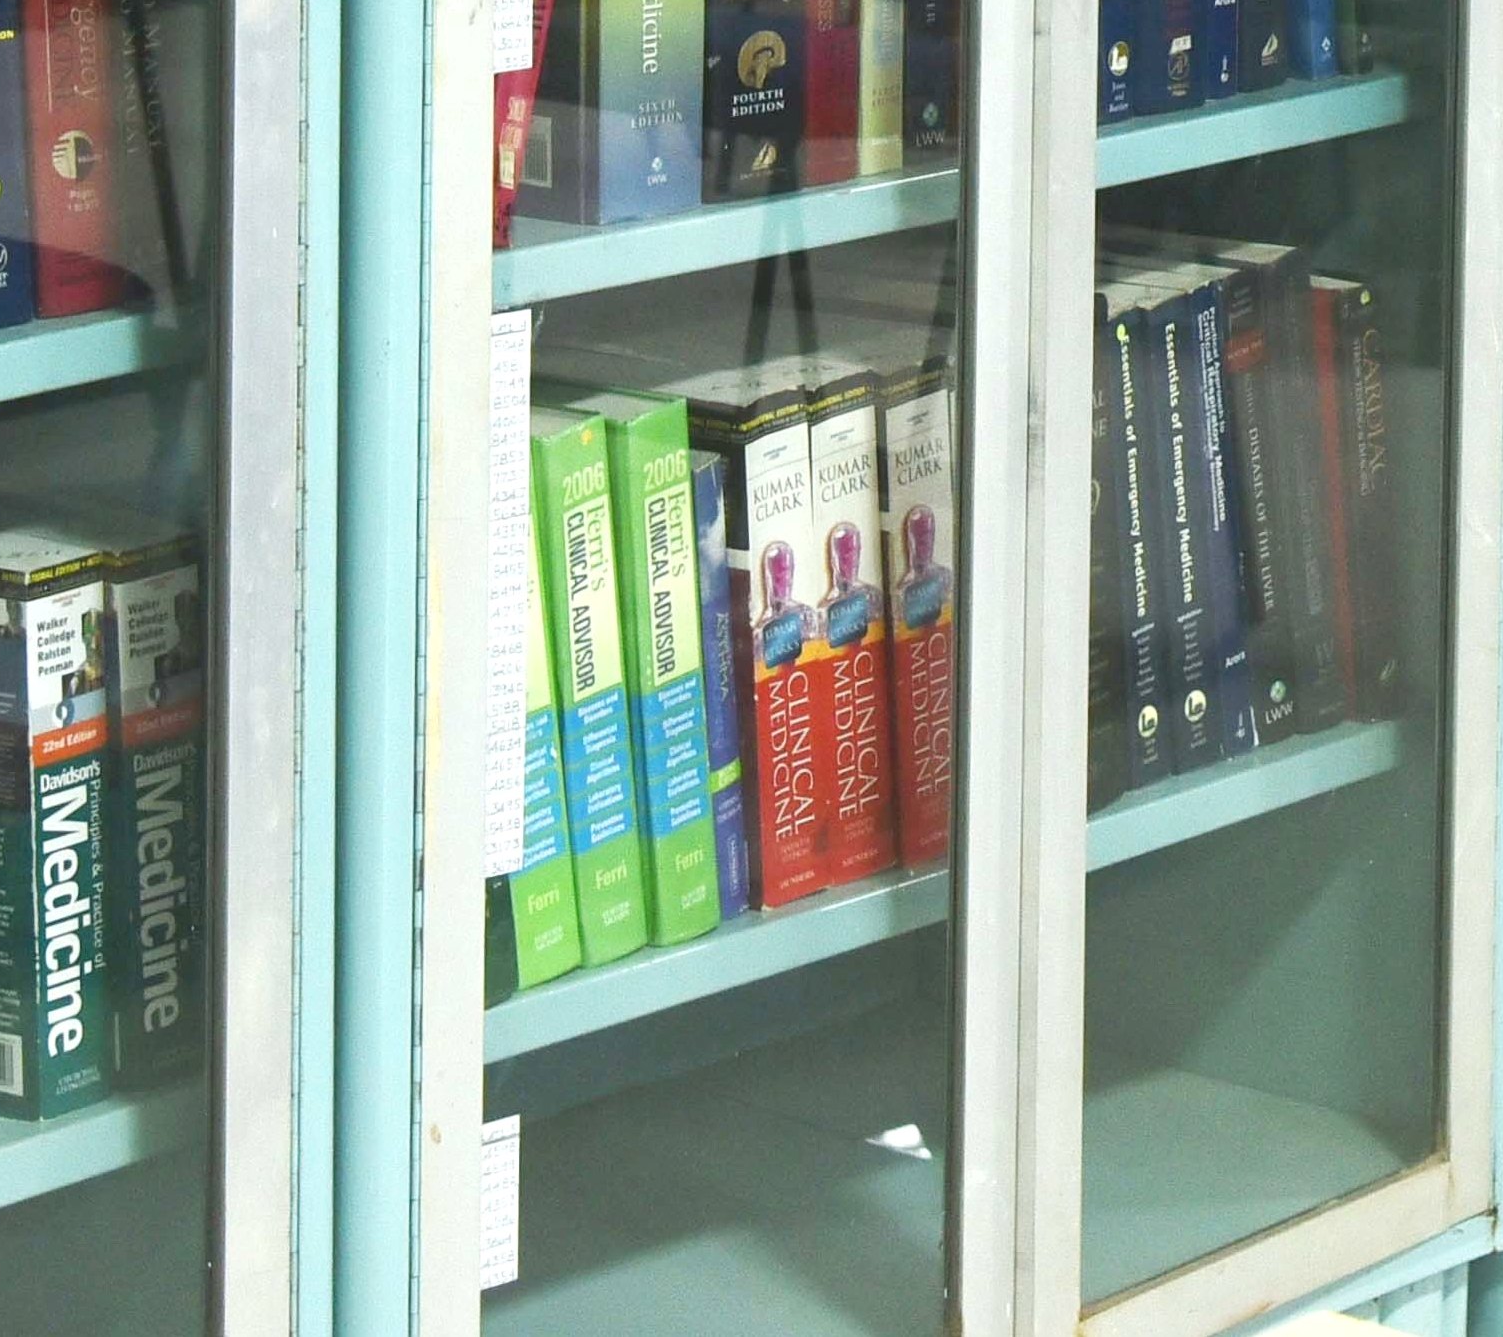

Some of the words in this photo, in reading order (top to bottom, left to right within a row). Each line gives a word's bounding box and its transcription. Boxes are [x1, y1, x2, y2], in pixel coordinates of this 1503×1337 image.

[562, 460, 606, 507] 2006
[643, 447, 688, 493] 2006
[817, 453, 872, 487] KUMAR
[820, 470, 872, 504] CLARK
[565, 509, 584, 601] CLINICAL
[645, 495, 668, 586] CLINICAL
[571, 604, 596, 695] ADVISOR
[653, 591, 676, 680] ADVISOR
[767, 679, 794, 842] MEDICINE
[786, 669, 817, 837] CLINICAL
[830, 659, 857, 821] MEDICINE
[851, 650, 880, 809] CLINICAL
[39, 759, 102, 793] Davidson's
[40, 784, 86, 1058] Medicine
[133, 769, 182, 1035] Medicine
